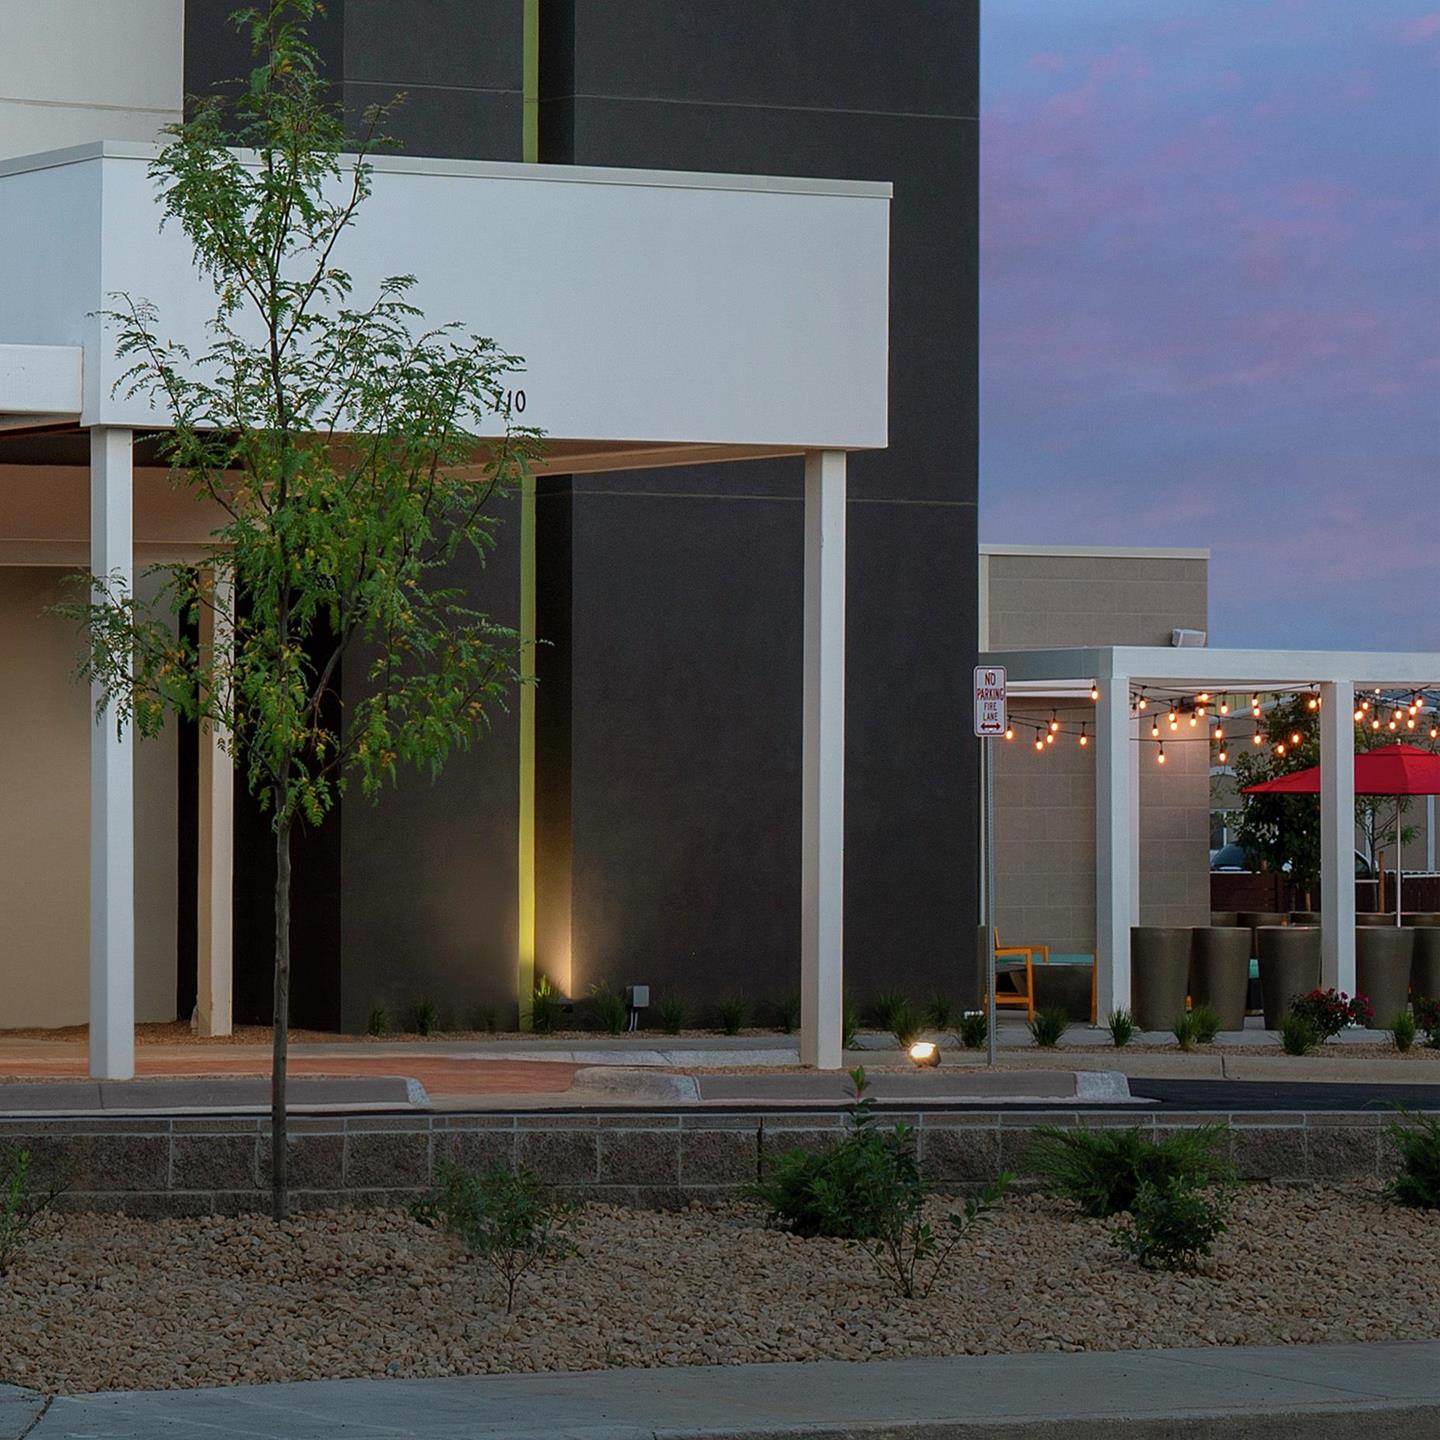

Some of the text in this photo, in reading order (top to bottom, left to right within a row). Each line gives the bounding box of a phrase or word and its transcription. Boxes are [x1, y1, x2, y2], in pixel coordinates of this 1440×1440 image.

[984, 673, 996, 686] NO
[976, 688, 1004, 701] PARKING
[984, 702, 997, 711] FIRE
[983, 712, 998, 721] LANE
